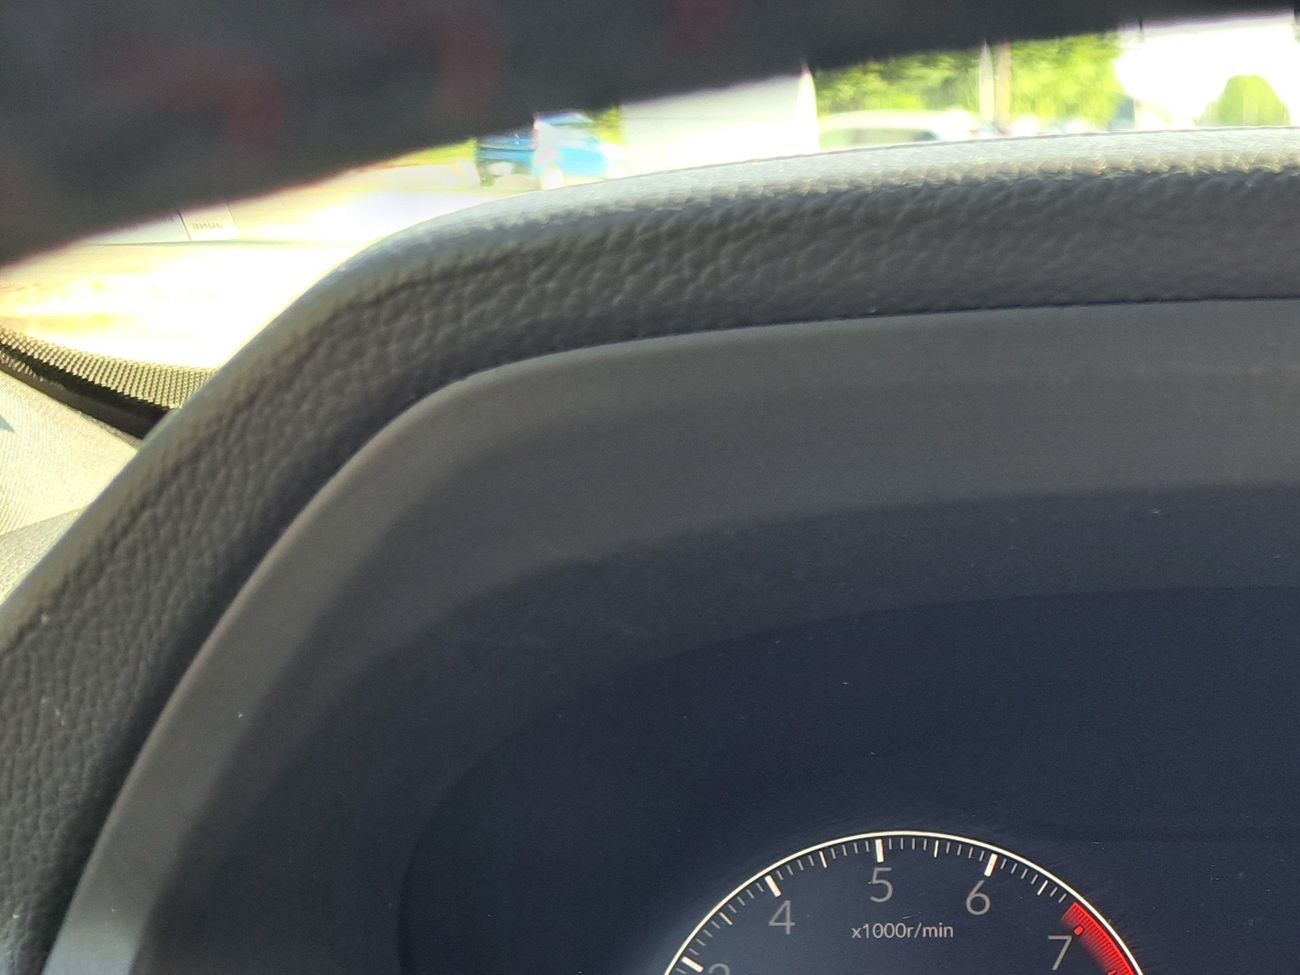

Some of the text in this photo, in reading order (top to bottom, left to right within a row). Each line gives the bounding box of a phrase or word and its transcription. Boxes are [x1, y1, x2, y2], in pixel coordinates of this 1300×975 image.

[868, 868, 892, 902] 5
[966, 880, 990, 915] 6
[769, 902, 795, 934] 4
[852, 923, 953, 938] x1000r/min
[1048, 935, 1073, 970] 7
